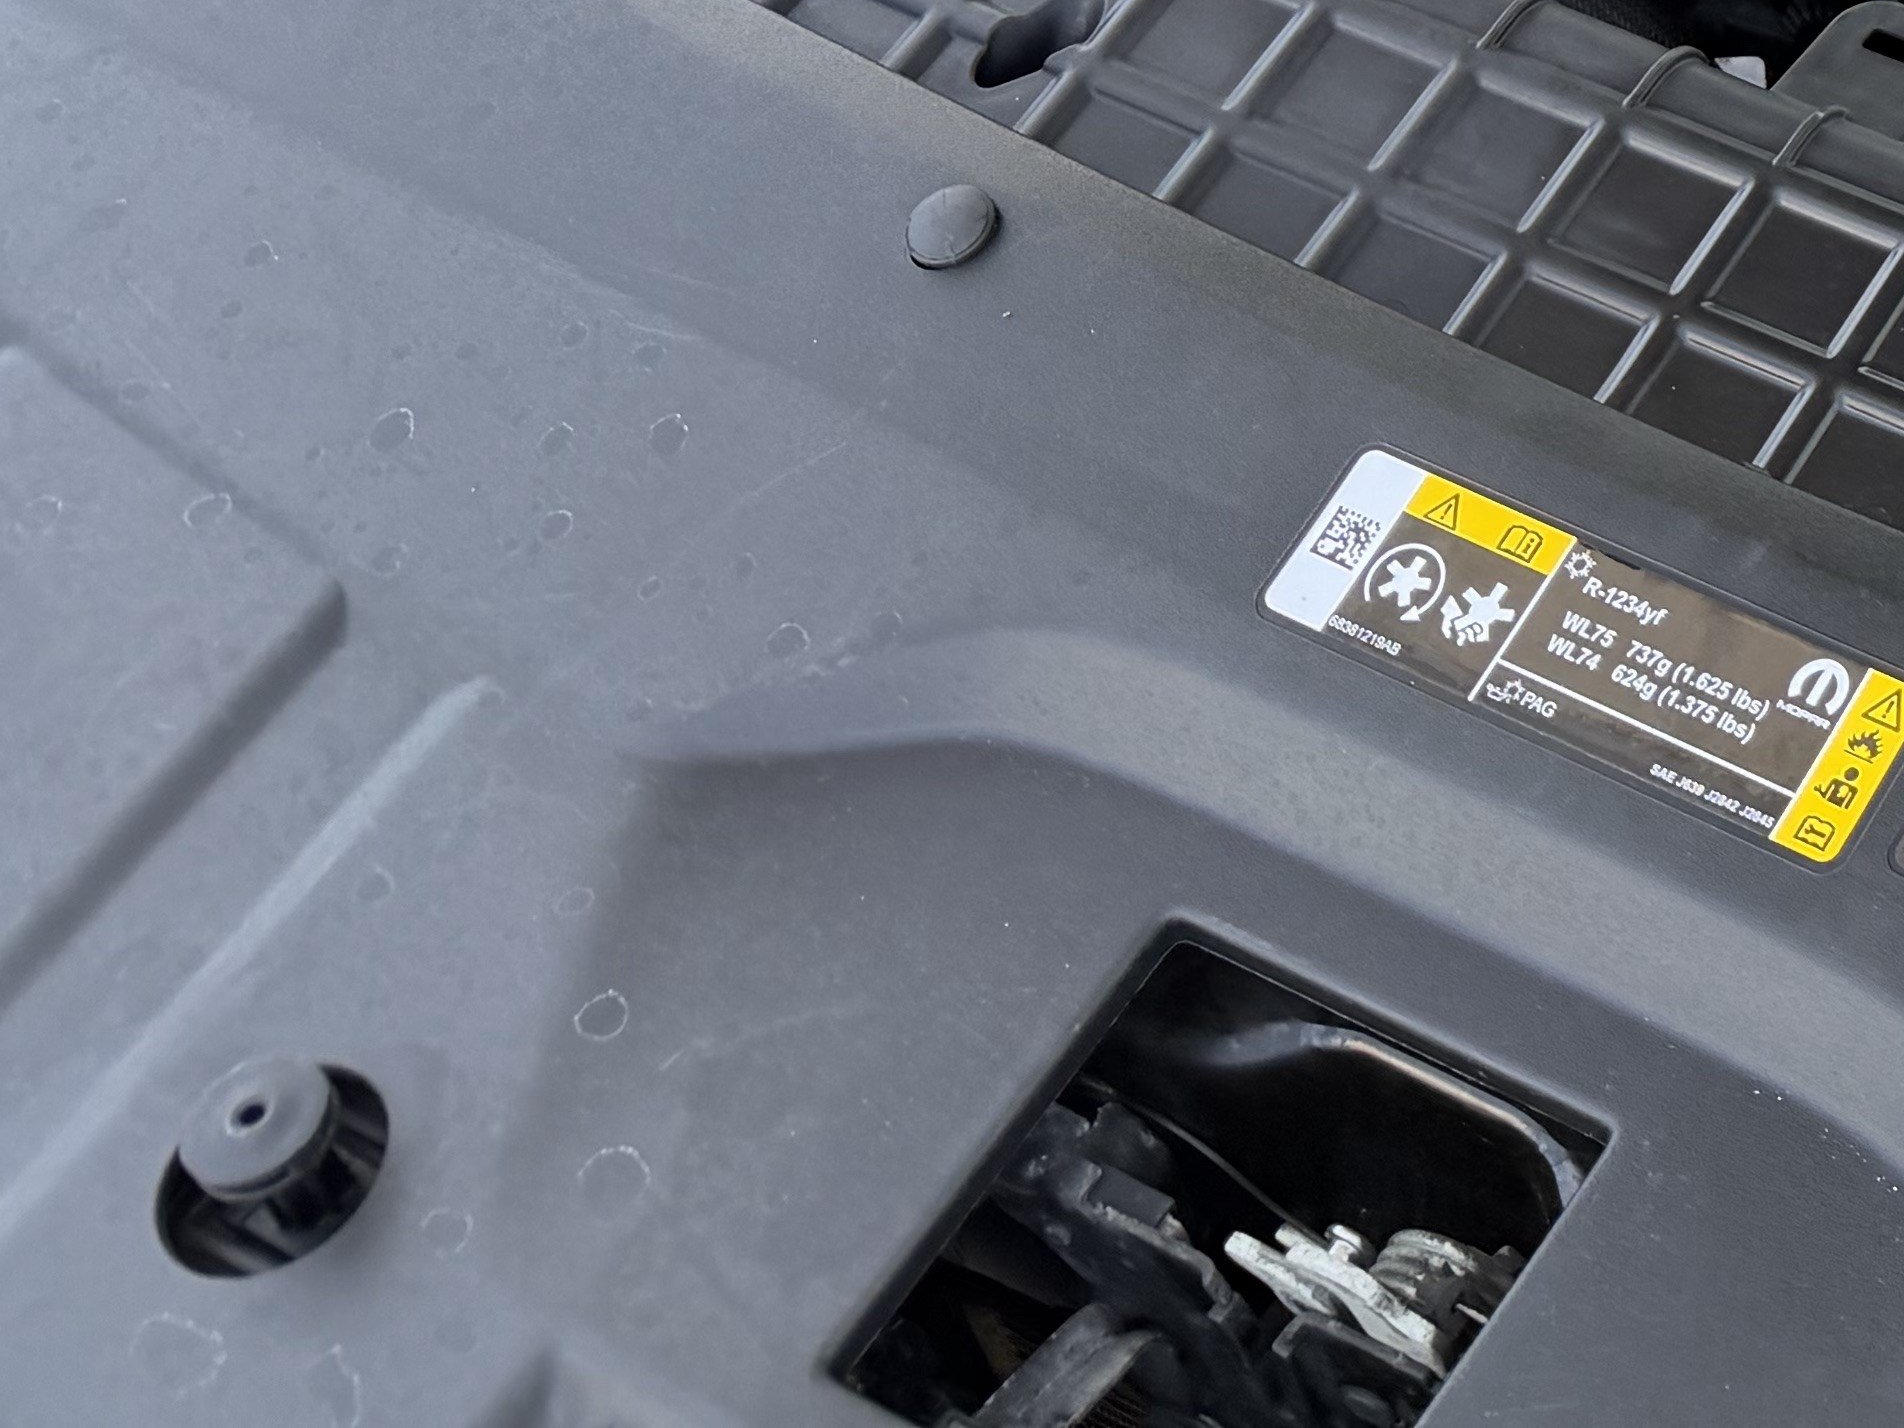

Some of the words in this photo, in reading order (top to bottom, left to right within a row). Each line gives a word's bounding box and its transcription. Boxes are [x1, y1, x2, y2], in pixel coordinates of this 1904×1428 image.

[1581, 574, 1670, 627] R-1234yf
[1545, 632, 1603, 673] WL74
[1610, 663, 1659, 703] 624g
[1655, 685, 1720, 727] (1.375
[1715, 711, 1756, 746] lbs)
[1561, 609, 1620, 651] WL75
[1625, 638, 1674, 679] 737g
[1670, 661, 1736, 703] (1.625
[1730, 686, 1771, 723] lbs)
[1518, 690, 1559, 719] PAG
[1649, 763, 1679, 786] SAE
